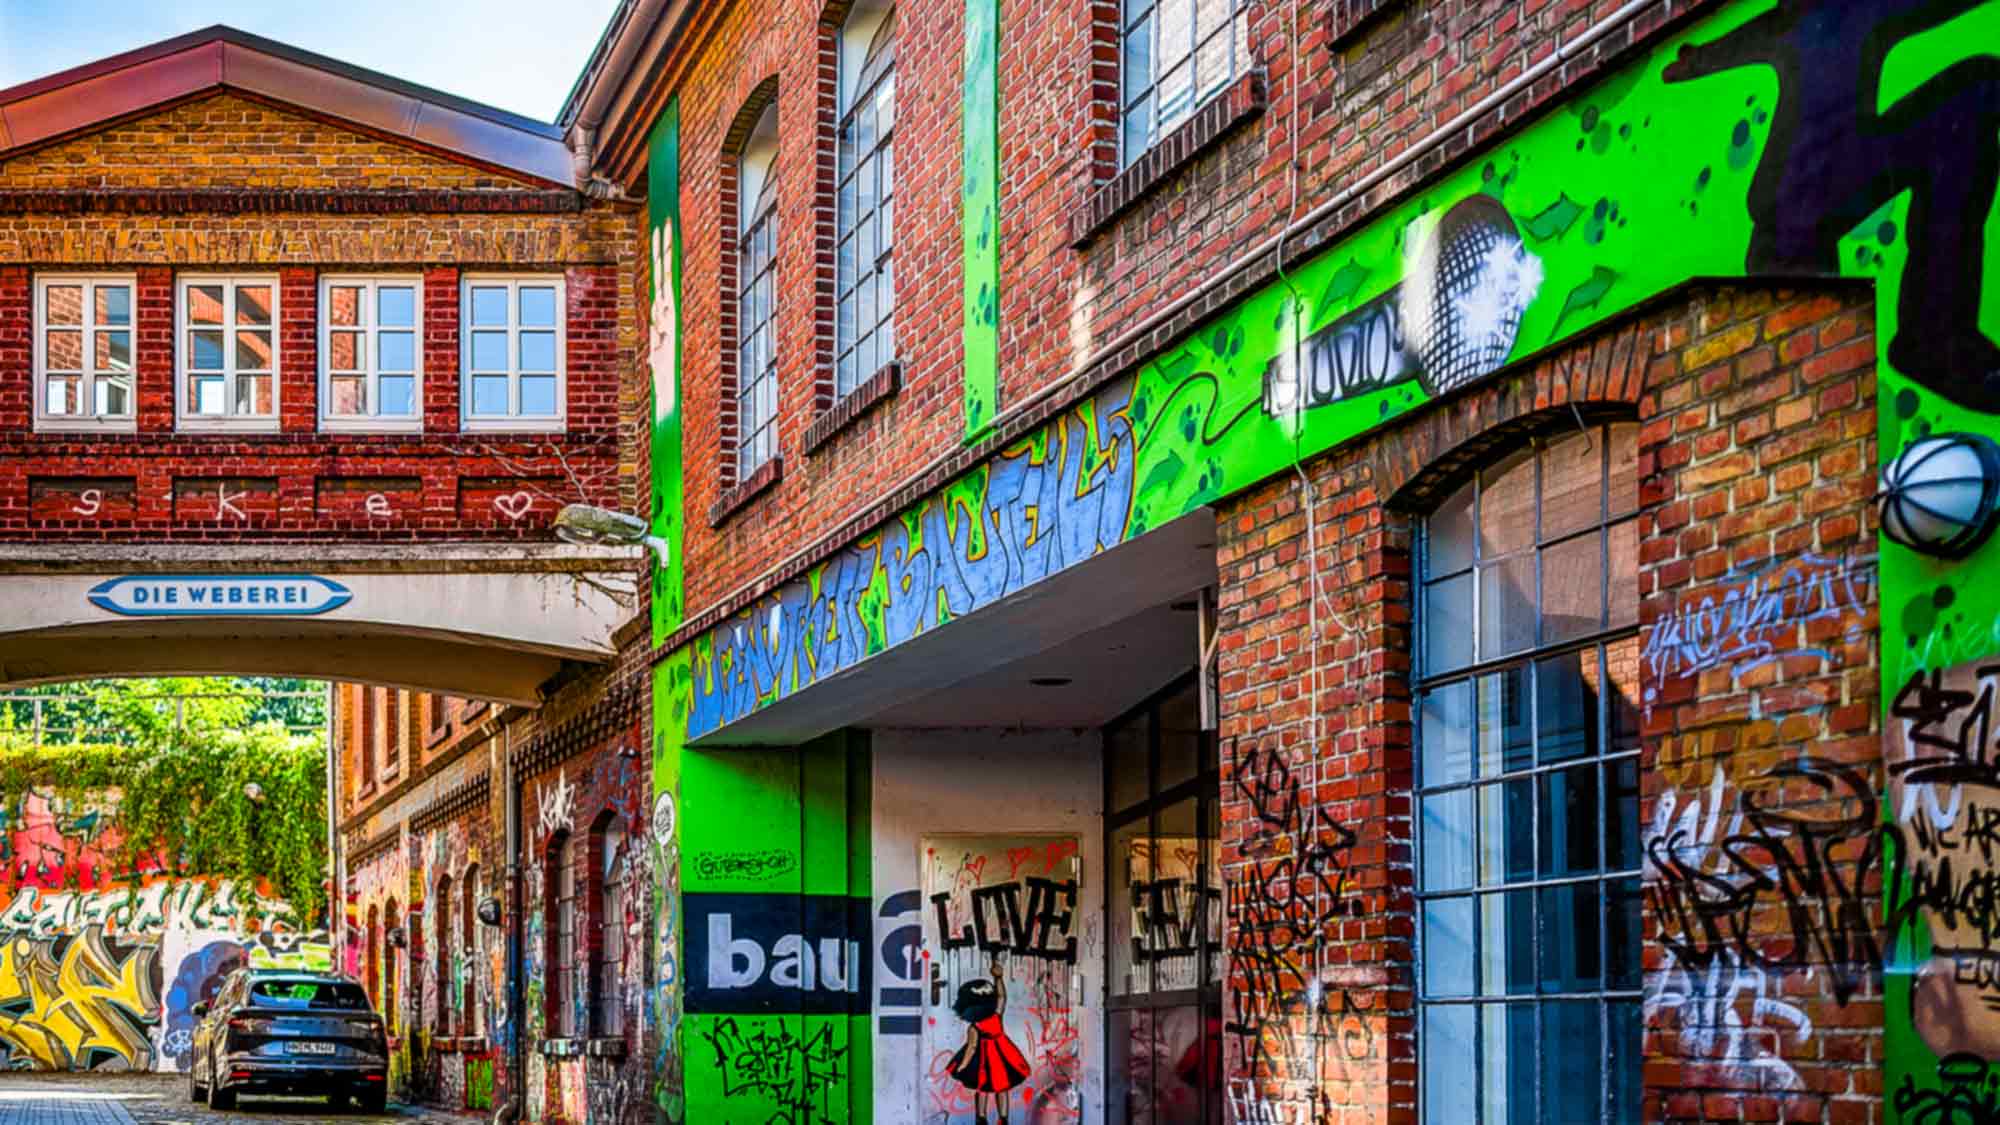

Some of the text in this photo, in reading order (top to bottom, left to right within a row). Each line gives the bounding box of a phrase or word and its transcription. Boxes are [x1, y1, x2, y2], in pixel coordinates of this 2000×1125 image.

[133, 586, 308, 603] DIE WEBEREI
[707, 913, 859, 993] bau
[931, 877, 1078, 965] LOVE
